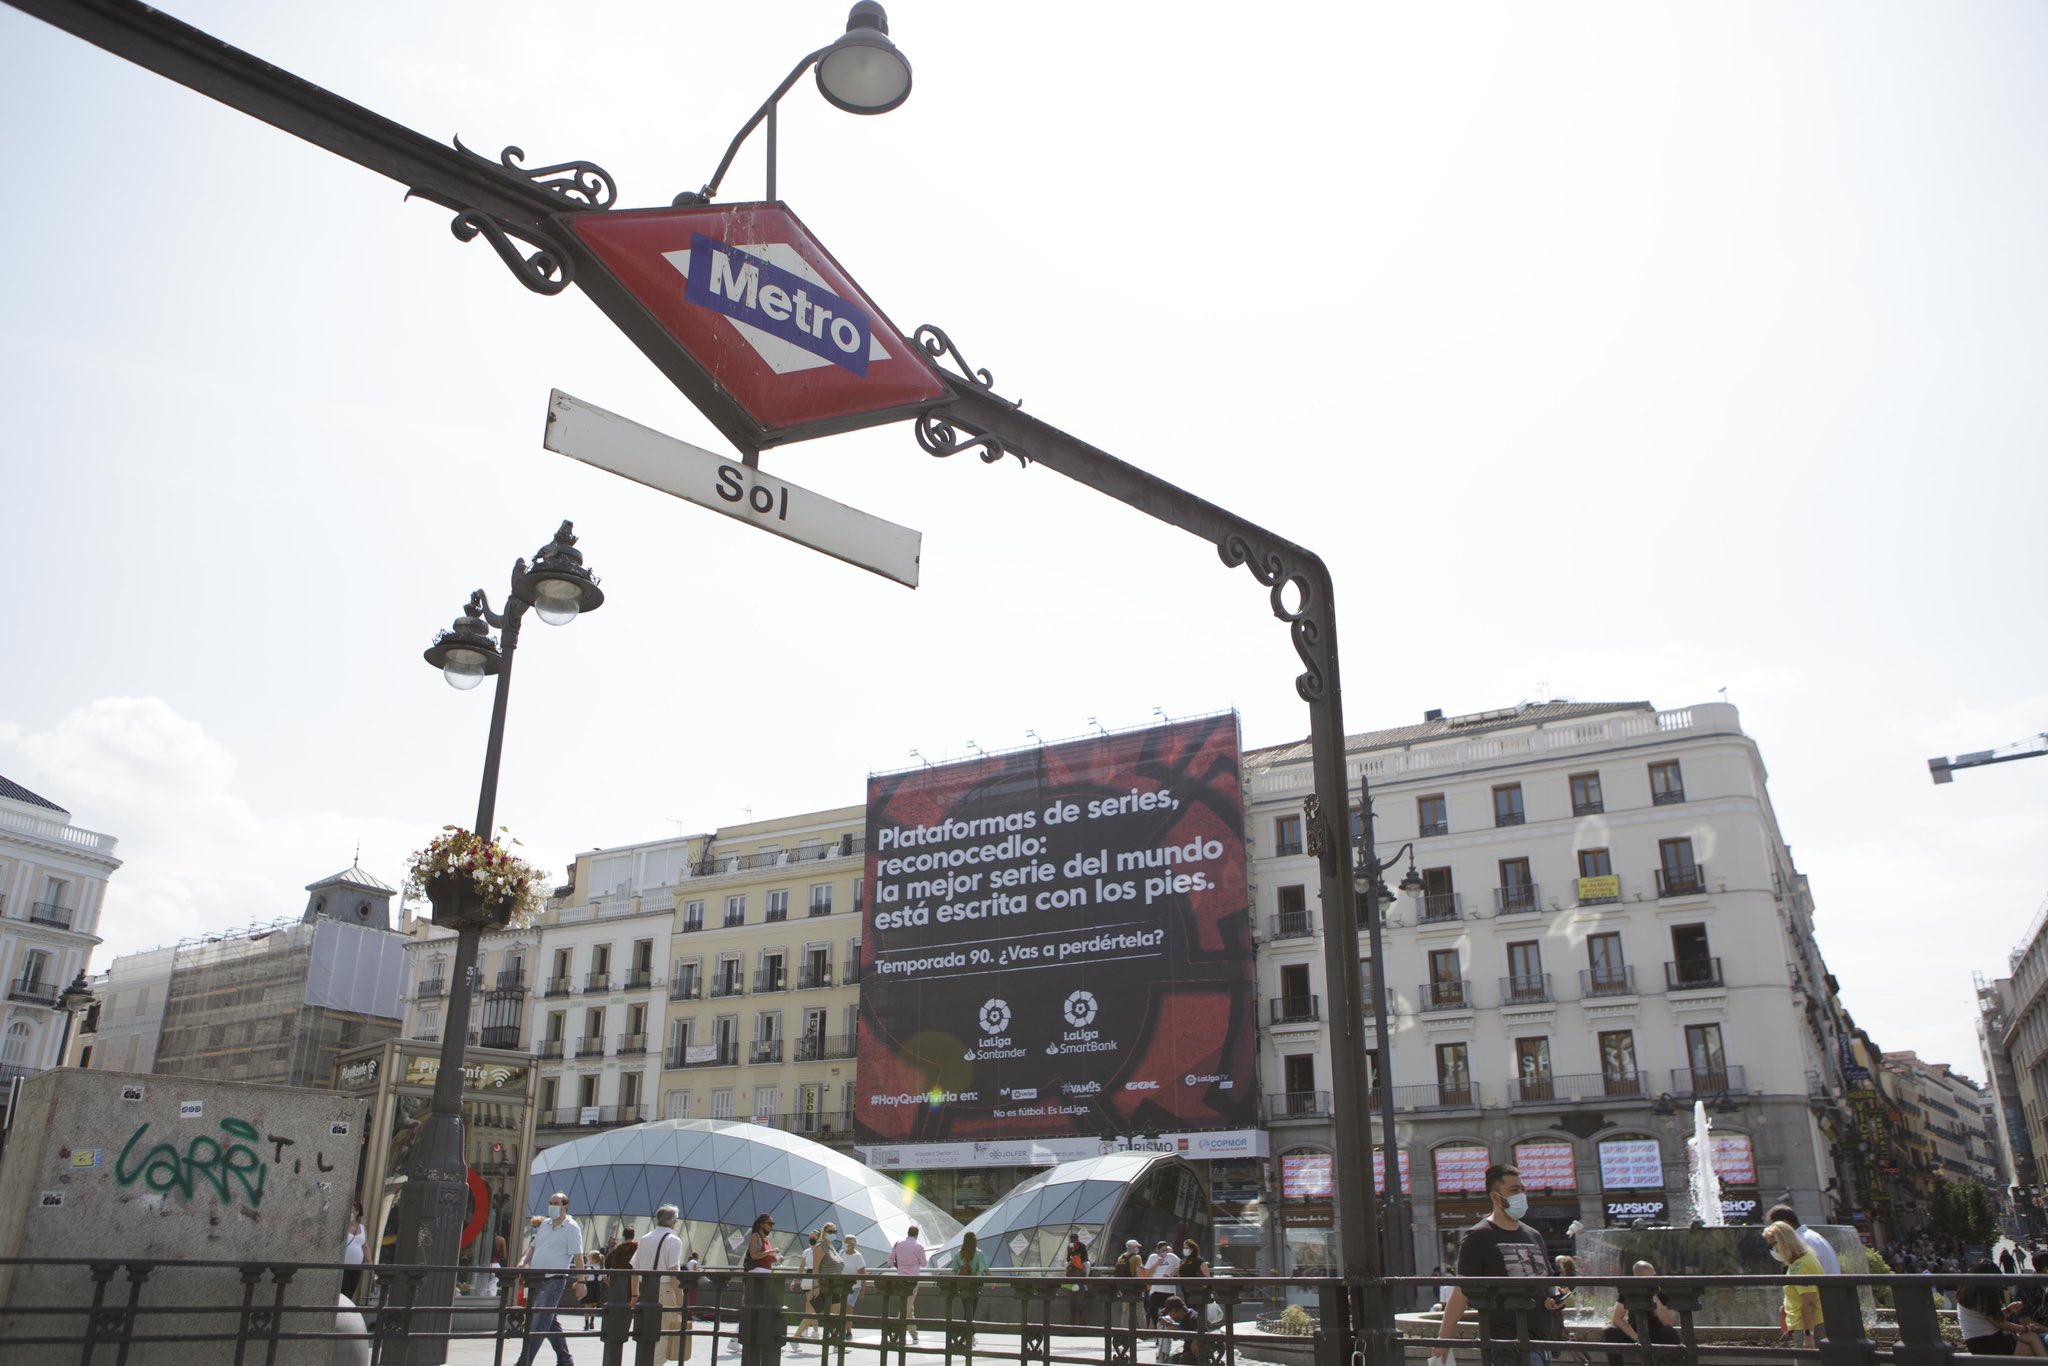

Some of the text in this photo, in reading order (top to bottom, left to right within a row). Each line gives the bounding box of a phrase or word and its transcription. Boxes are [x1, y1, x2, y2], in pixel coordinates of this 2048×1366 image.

[708, 250, 861, 354] Metro
[716, 465, 788, 521] Sol
[878, 788, 1180, 851] Plataformas de series,
[876, 833, 1048, 877] reconocedlo:
[876, 835, 1223, 911] la mejor serie del mundo
[874, 868, 1215, 931] está escrita con los pies.
[875, 929, 1165, 975] Temporada 90. ¿Vas a perdértela?
[1064, 1029, 1099, 1041] LaLiga
[978, 1036, 1012, 1049] LaLiga
[1059, 1040, 1118, 1054] SmartBank
[976, 1048, 1027, 1060] Santander
[1125, 1080, 1160, 1090] GOL
[1197, 1074, 1220, 1083] LaLiga
[1060, 1081, 1102, 1095] #VAMOS
[871, 1091, 957, 1107] #HayQueVivirla
[960, 1091, 978, 1101] en:
[993, 1105, 1091, 1118] No es fútbol. Es LaLiga.
[1210, 1138, 1247, 1147] COPMOR
[1608, 1202, 1664, 1214] ZAPSHOP
